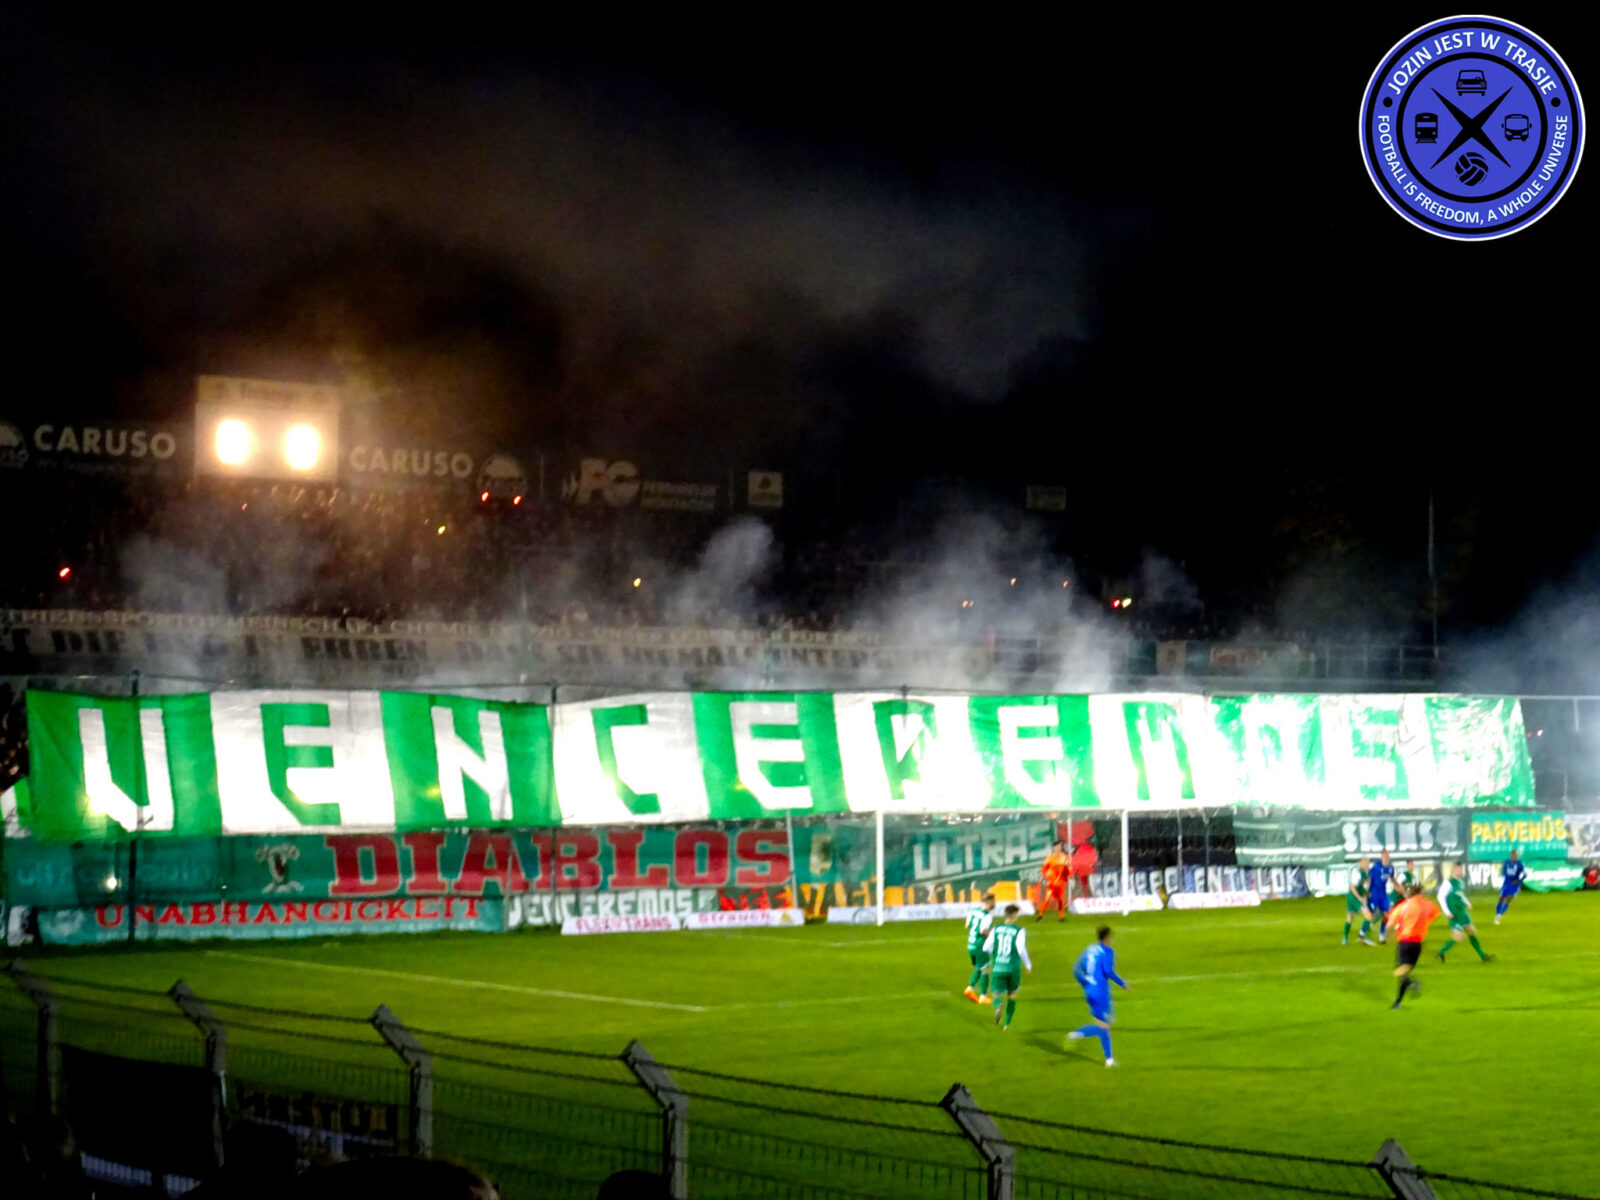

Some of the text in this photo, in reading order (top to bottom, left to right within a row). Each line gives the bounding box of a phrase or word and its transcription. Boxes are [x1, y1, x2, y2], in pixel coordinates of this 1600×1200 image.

[34, 424, 176, 460] CARUSO
[350, 445, 474, 479] CARUSO
[78, 695, 1522, 834] VENCEREMOS
[912, 823, 1053, 881] ULTRAS
[1342, 821, 1434, 851] SKINS
[325, 830, 791, 897] DIABLOS
